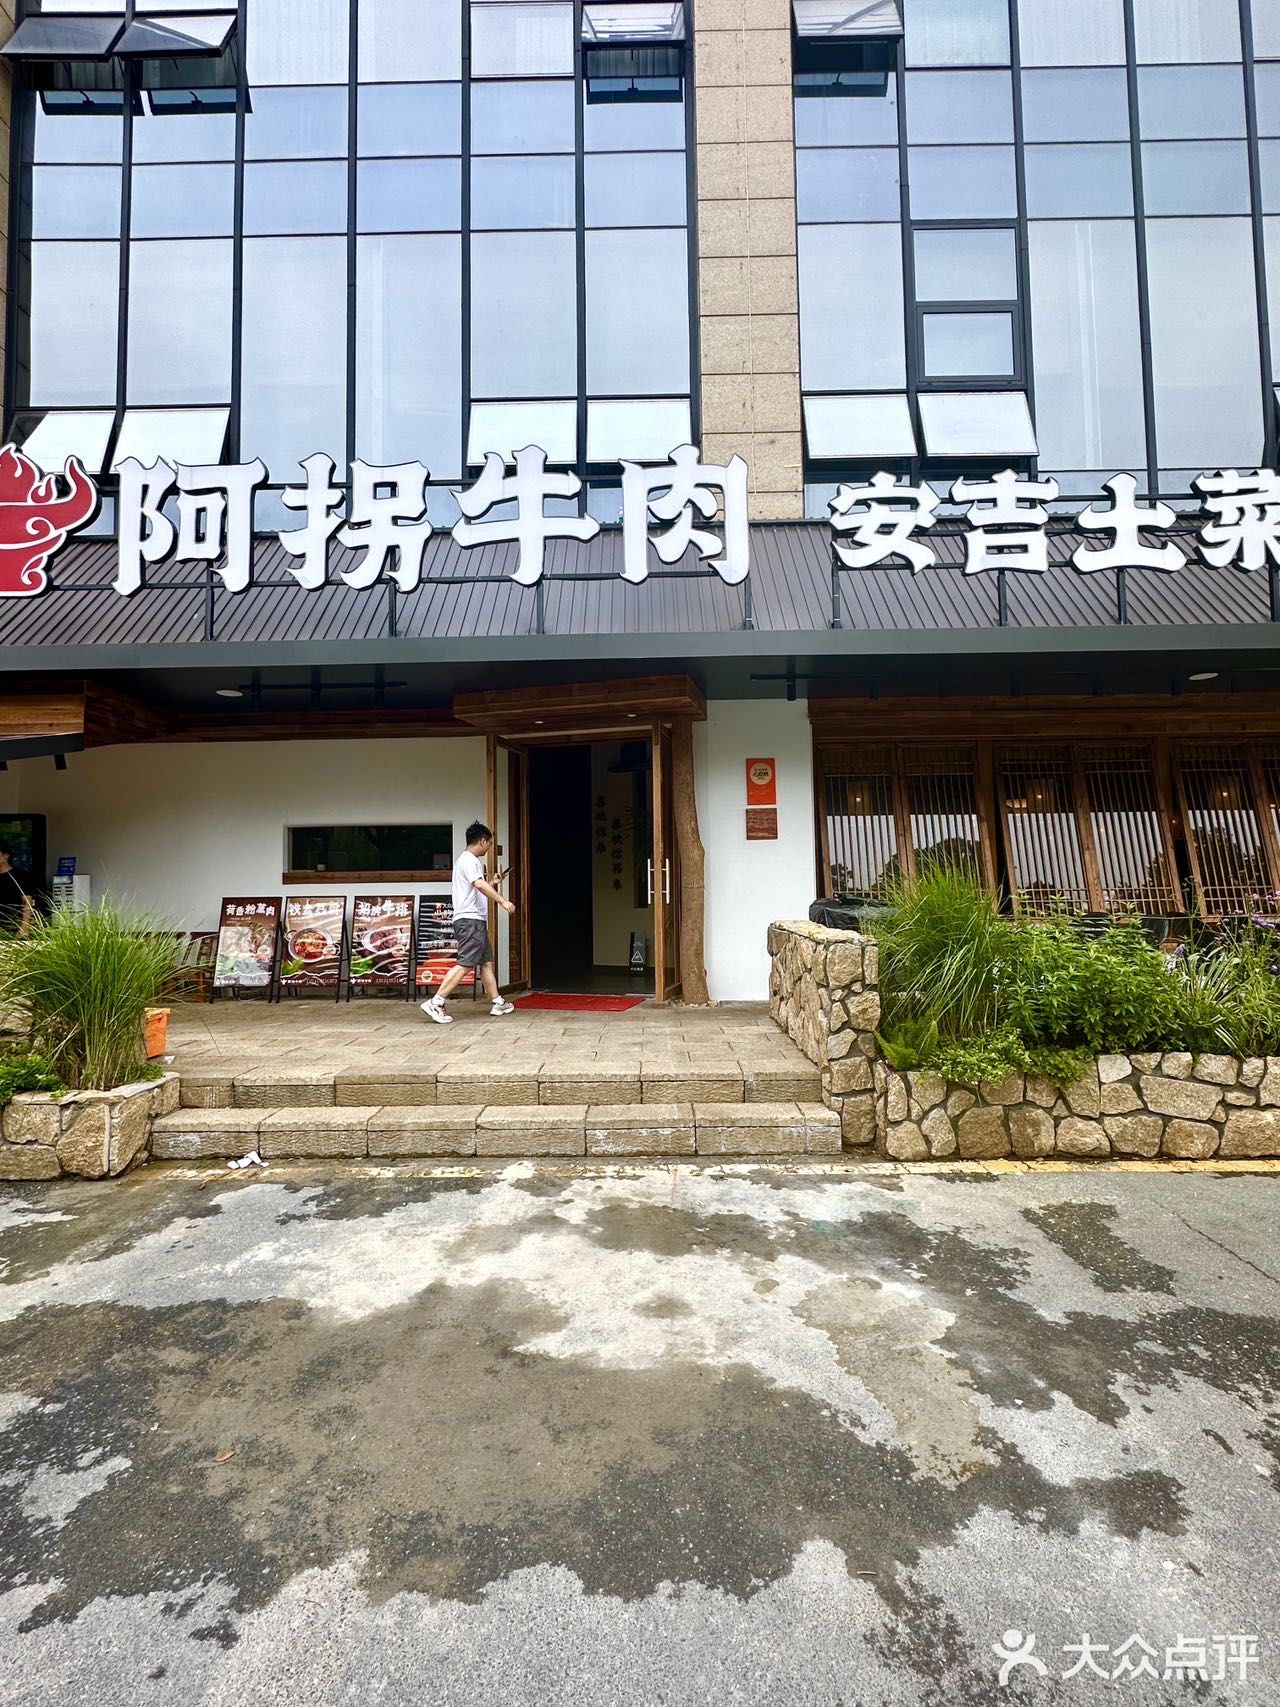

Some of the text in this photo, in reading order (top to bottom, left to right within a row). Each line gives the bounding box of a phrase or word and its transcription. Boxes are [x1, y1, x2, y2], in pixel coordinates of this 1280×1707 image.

[113, 444, 1280, 595] 阿拐牛肉 安吉土菜
